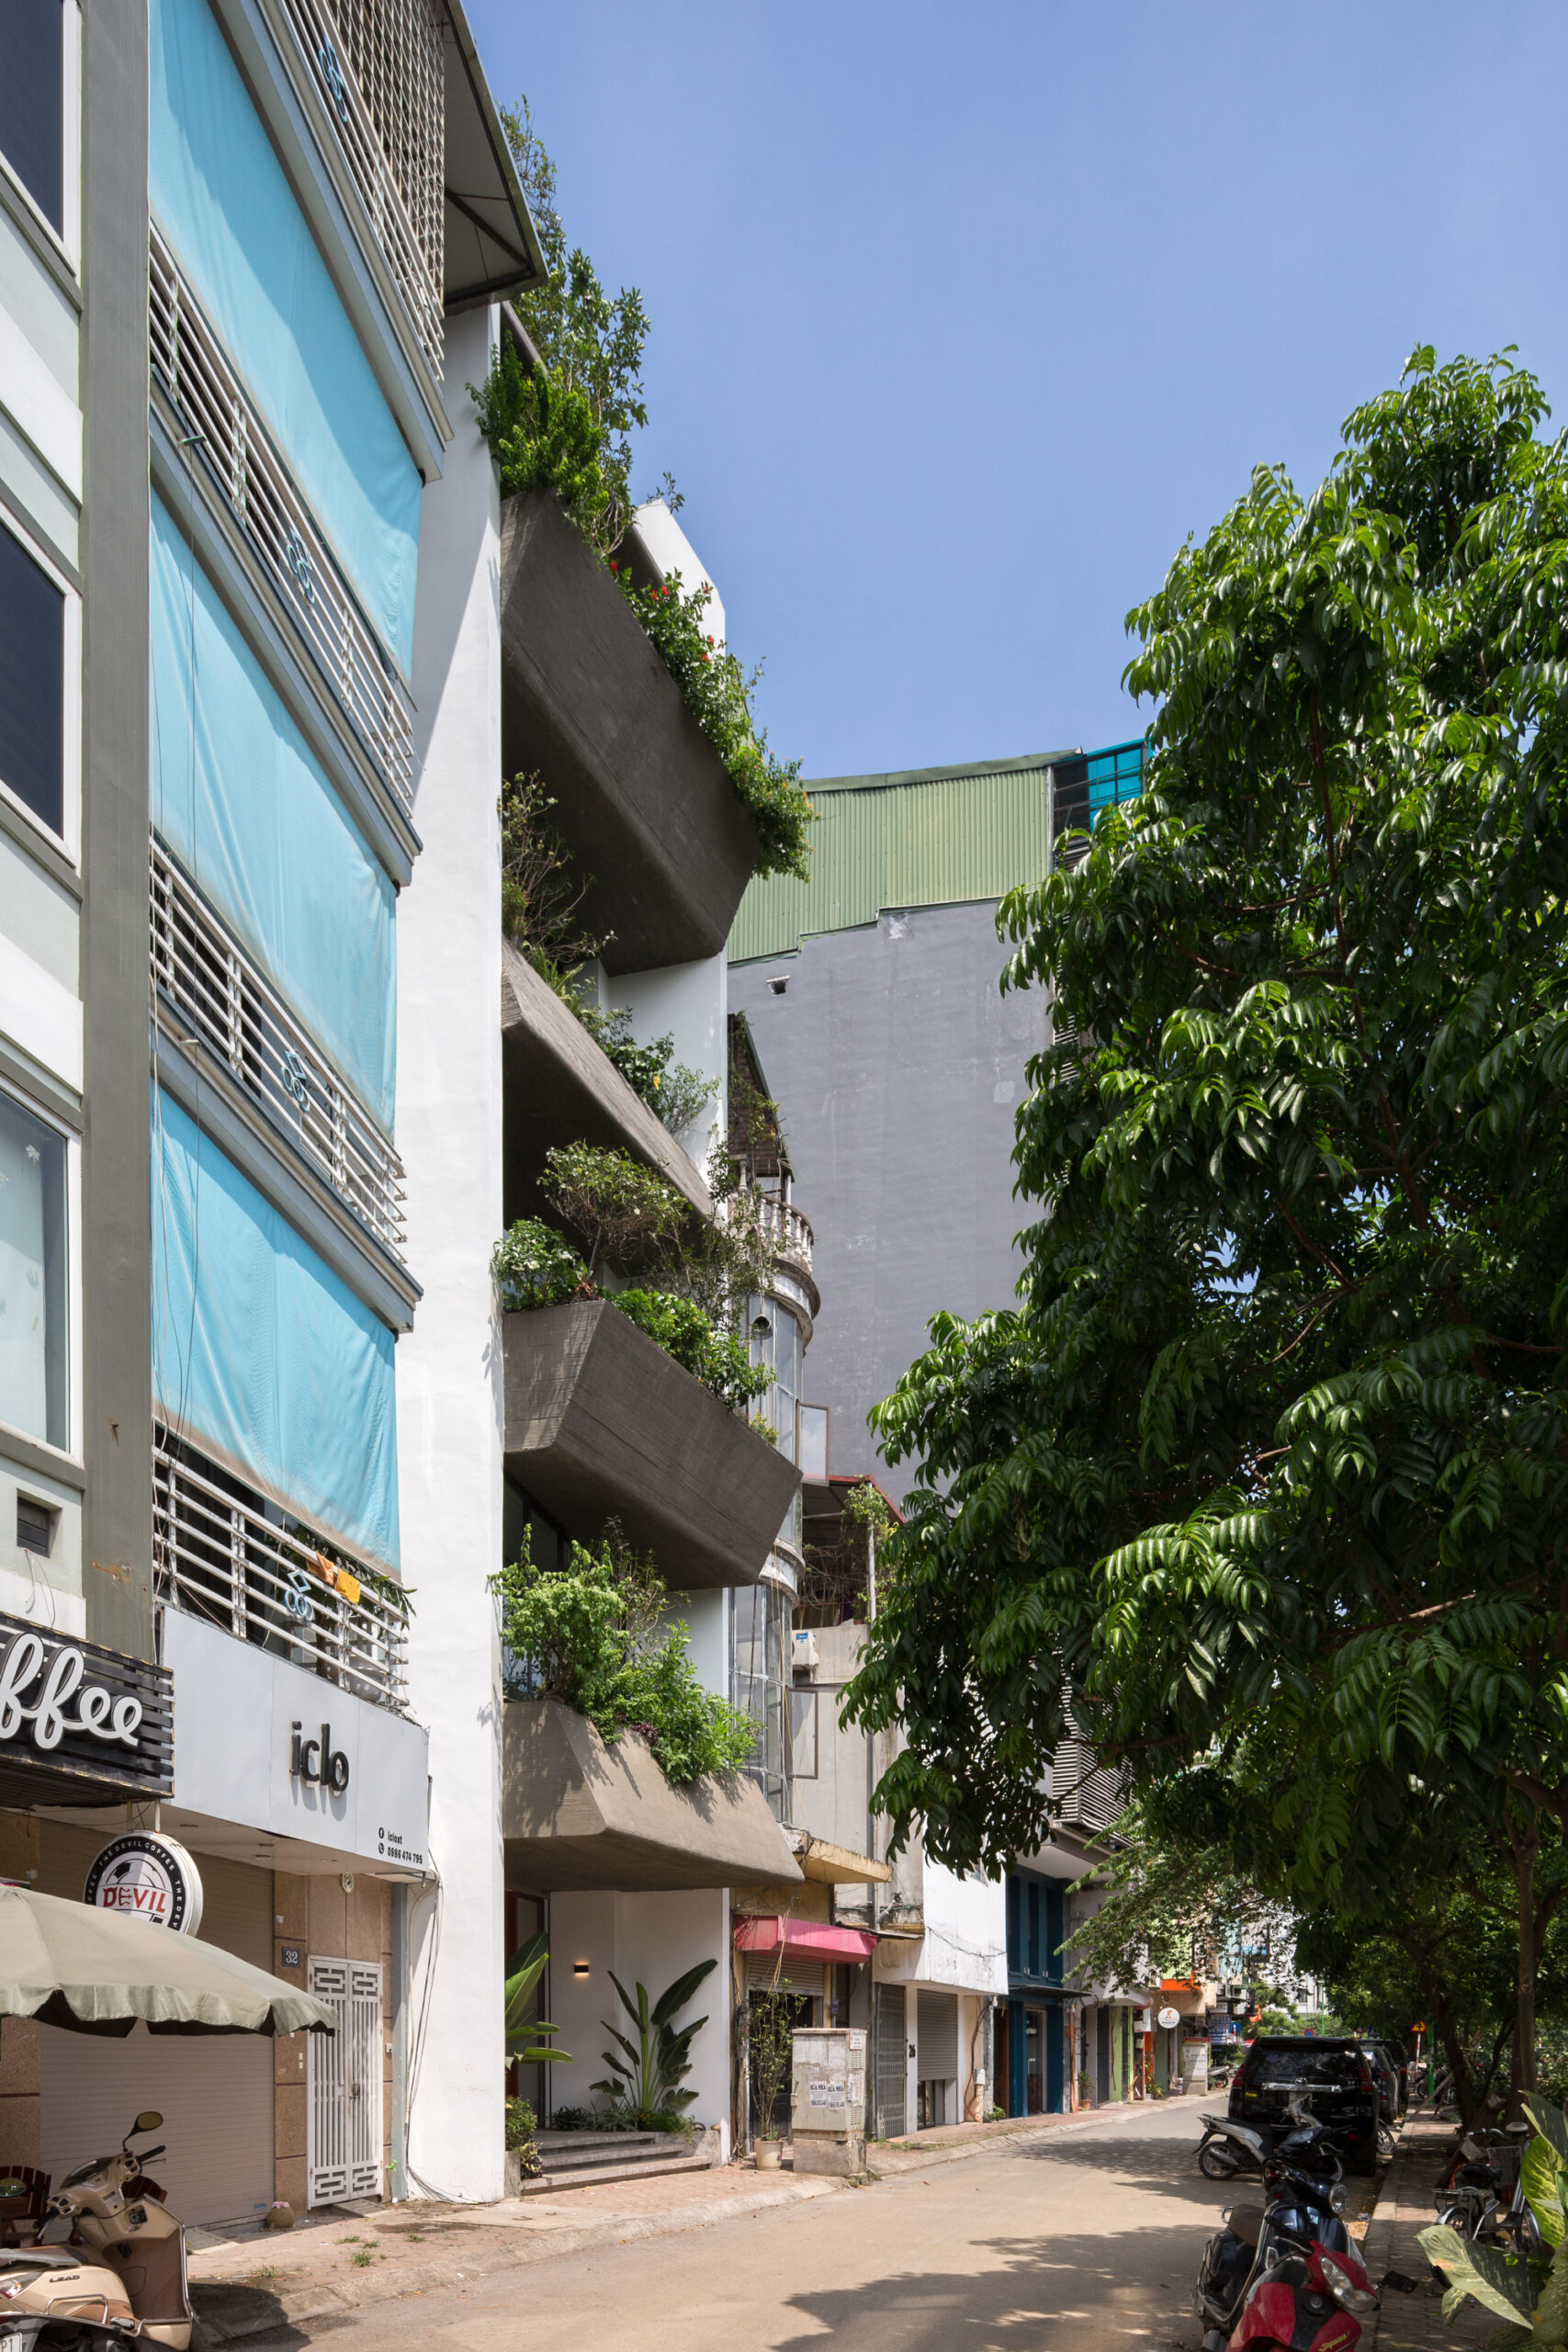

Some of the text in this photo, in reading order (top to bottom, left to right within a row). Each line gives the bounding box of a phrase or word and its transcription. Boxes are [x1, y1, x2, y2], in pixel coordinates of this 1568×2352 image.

[290, 1721, 349, 1792] iclo
[99, 1840, 175, 1871] THE DEVIL COFFEE
[402, 1850, 412, 1862] 474
[412, 1853, 423, 1865] 795
[103, 1886, 165, 1913] DEVIL
[285, 1950, 299, 1964] 32
[50, 2275, 80, 2283] LEAD
